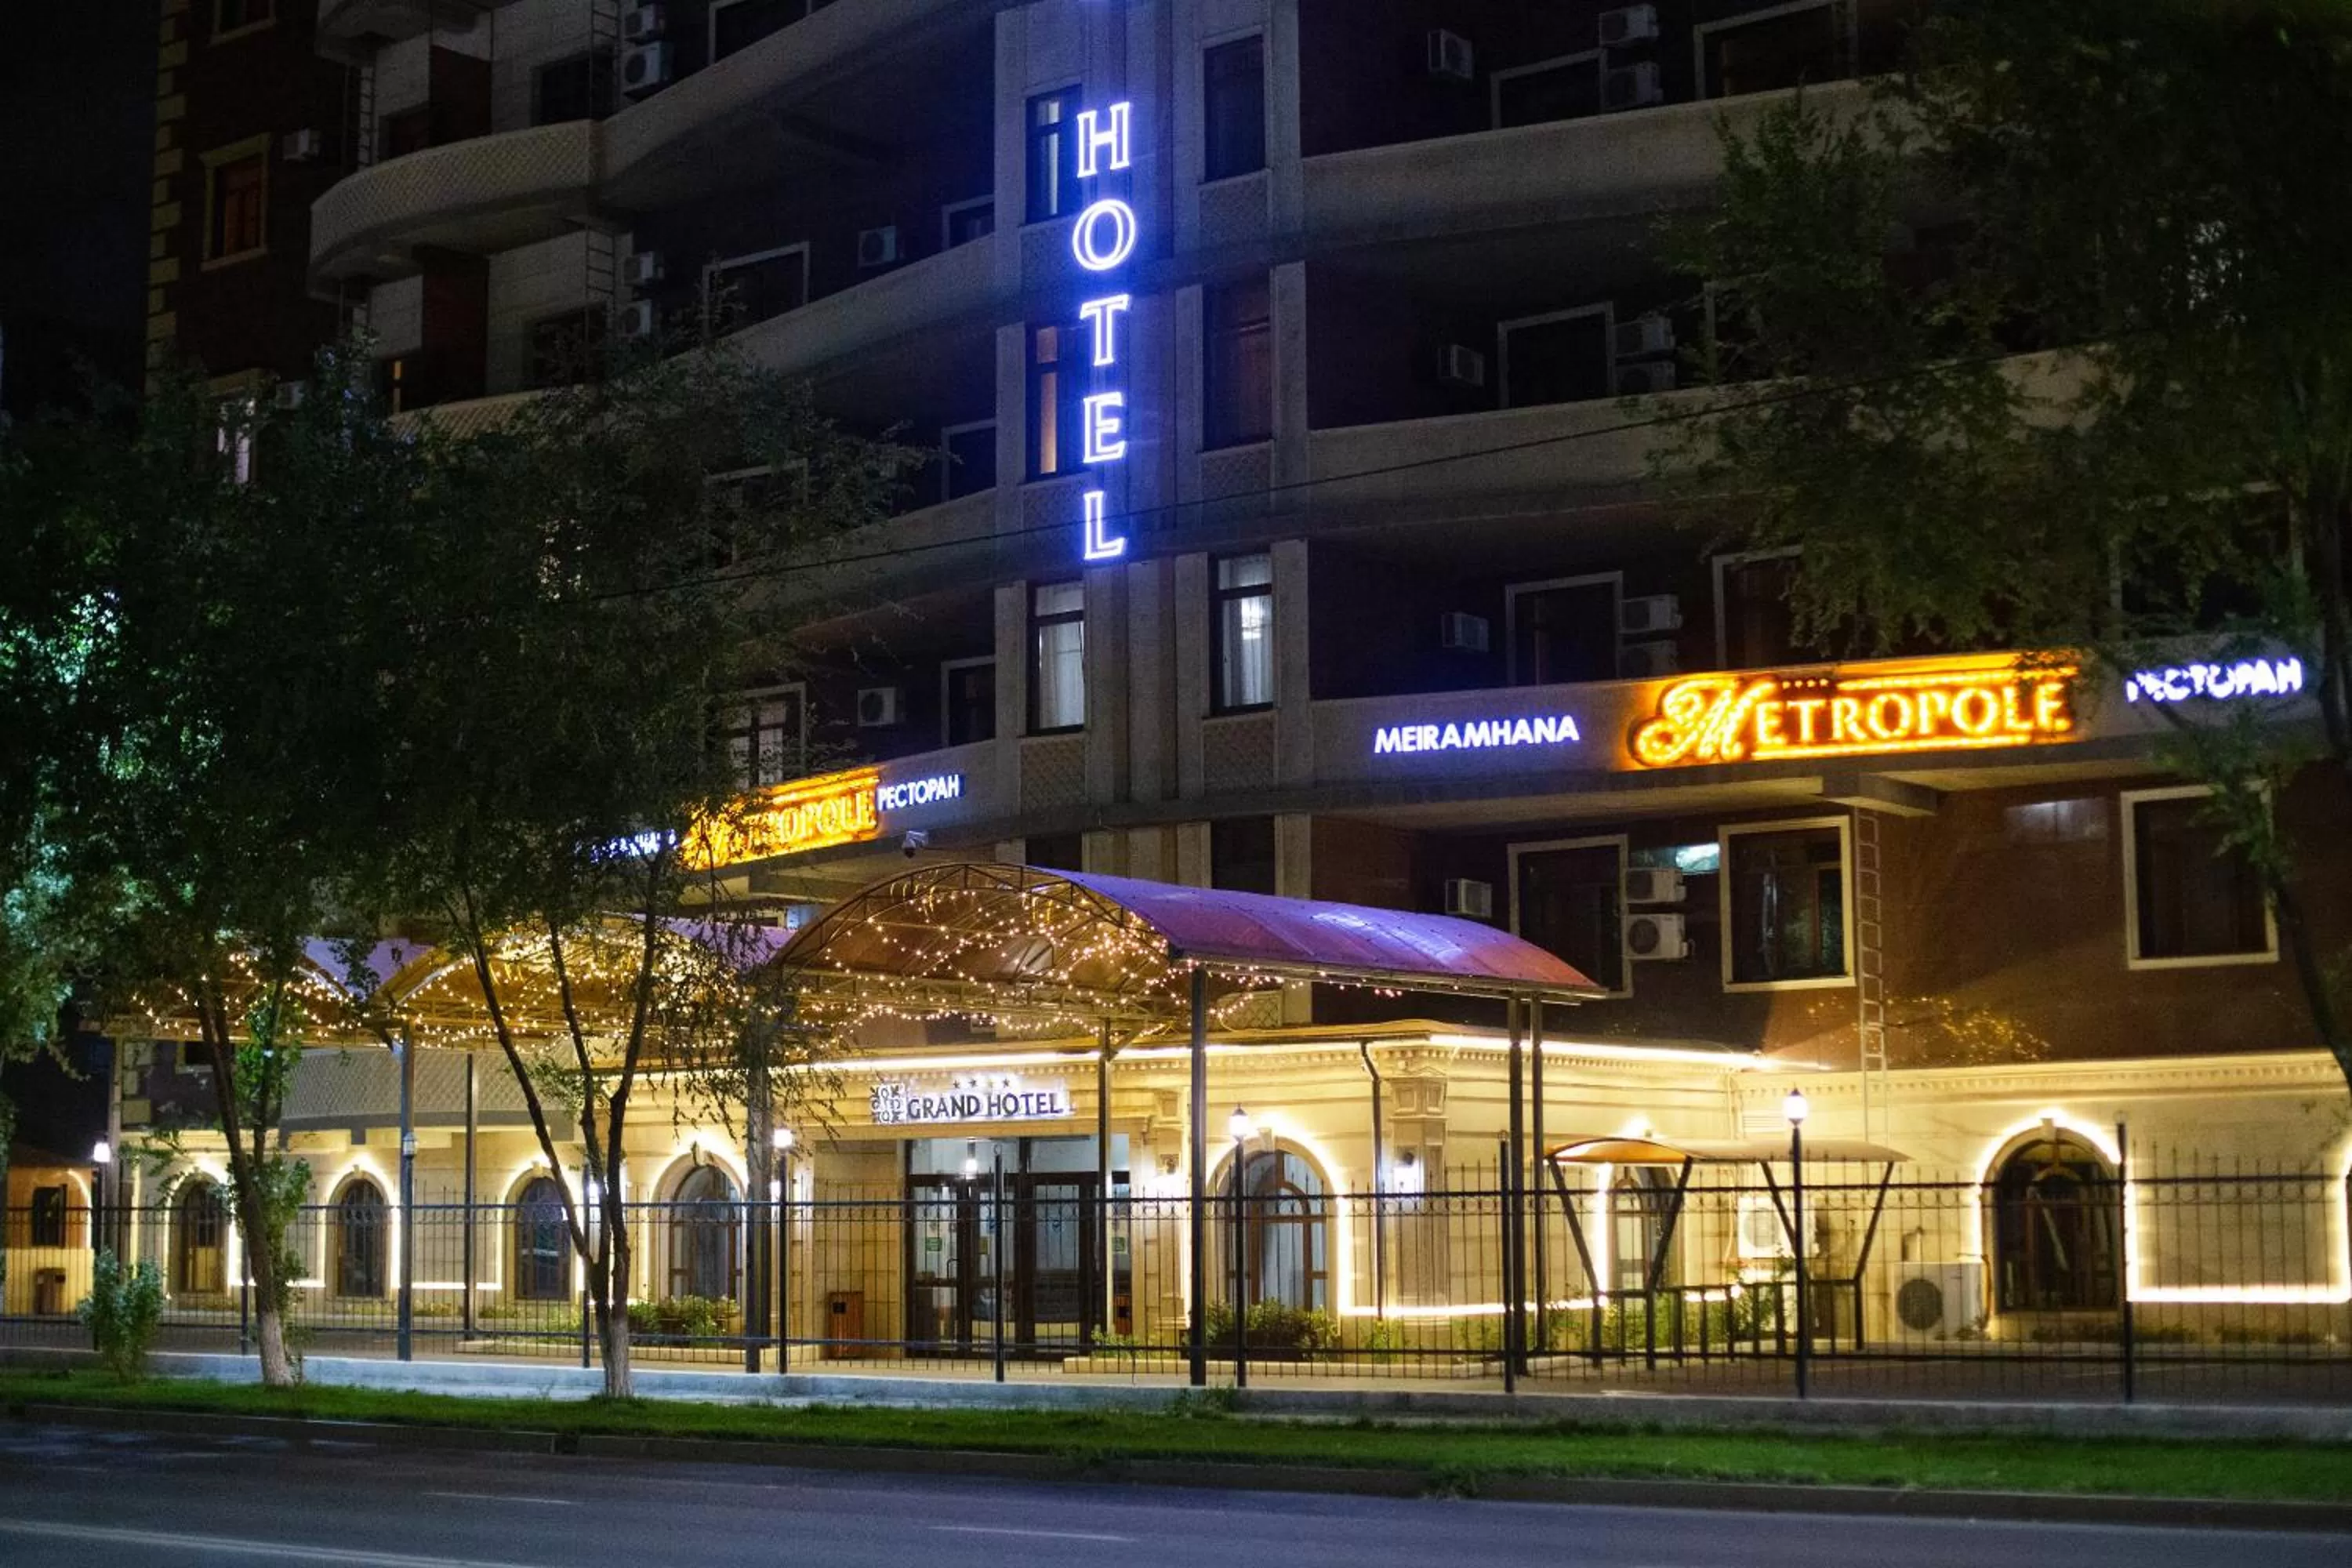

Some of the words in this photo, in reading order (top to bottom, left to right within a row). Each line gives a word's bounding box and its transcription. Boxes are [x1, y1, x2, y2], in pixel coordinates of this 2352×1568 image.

[1073, 102, 1136, 560] HOTEL
[1374, 714, 1580, 753] MEIRAMHANA
[1634, 677, 2072, 763] METROPOLE
[877, 774, 959, 811] РЕСТОРАН
[906, 1094, 980, 1120] GRAND
[987, 1092, 1063, 1117] HOTEL
